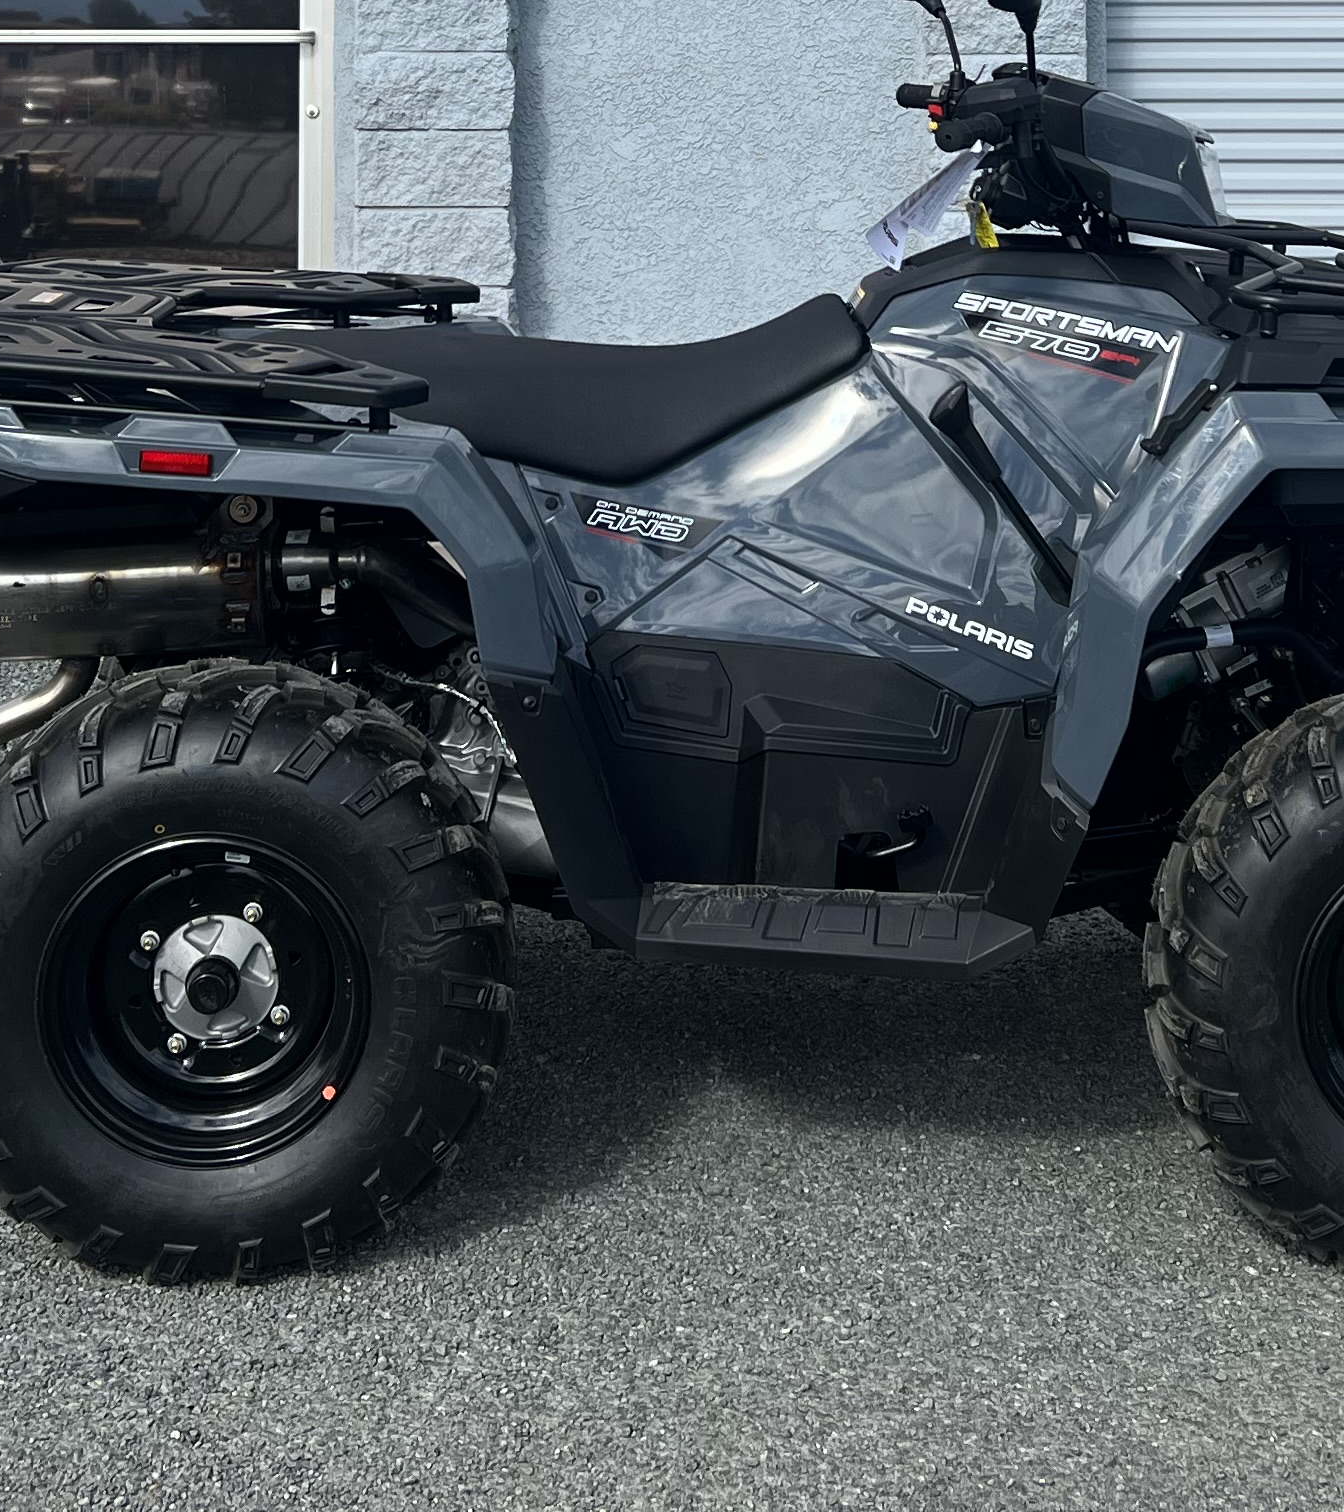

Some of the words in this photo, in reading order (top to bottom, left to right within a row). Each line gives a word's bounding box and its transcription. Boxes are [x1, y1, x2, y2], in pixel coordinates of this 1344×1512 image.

[953, 292, 1179, 353] SPORTSMAN
[978, 320, 1100, 362] 570
[586, 508, 689, 543] AWD
[625, 506, 694, 526] DEMAND
[905, 596, 1035, 660] POLARIS
